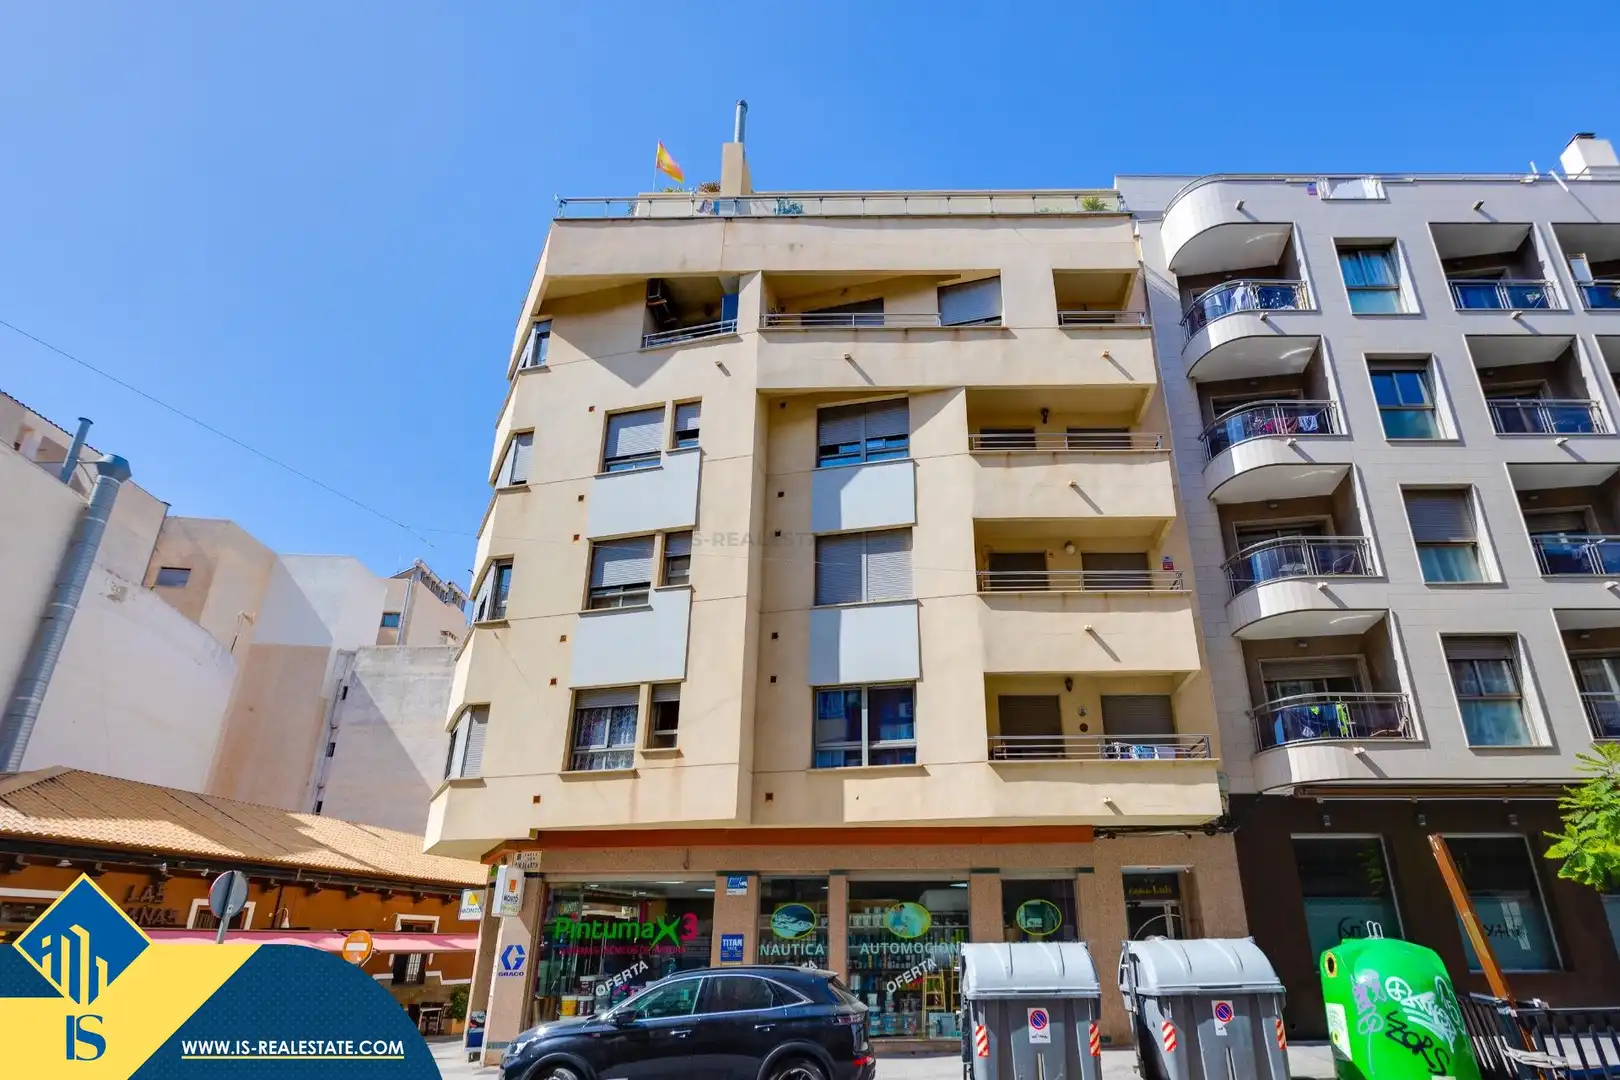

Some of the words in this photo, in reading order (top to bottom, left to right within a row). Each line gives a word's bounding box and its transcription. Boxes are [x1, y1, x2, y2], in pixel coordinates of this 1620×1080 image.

[722, 938, 743, 947] TITAN
[760, 943, 825, 956] NAUTICA
[595, 960, 649, 996] OFERTA
[886, 957, 938, 993] OFERTA
